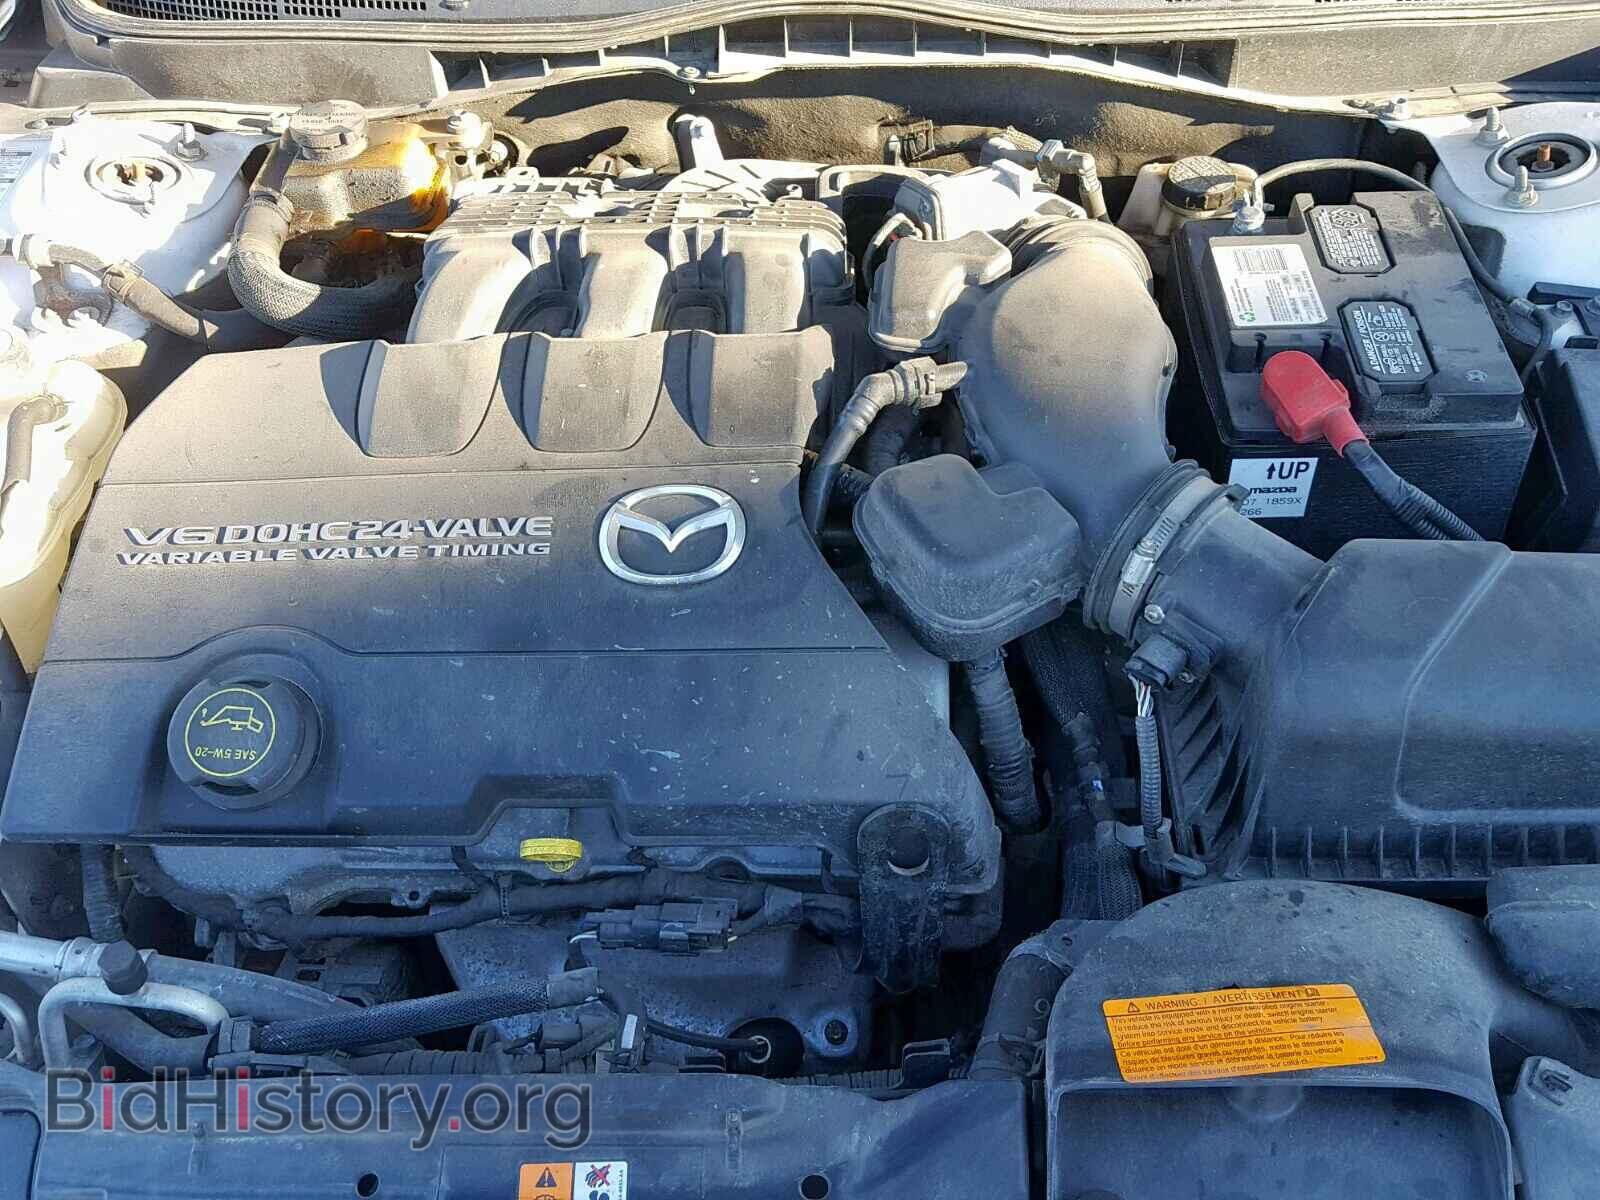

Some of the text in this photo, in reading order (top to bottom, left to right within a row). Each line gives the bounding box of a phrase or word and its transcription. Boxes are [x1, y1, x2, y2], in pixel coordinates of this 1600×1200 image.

[1362, 339, 1379, 365] DANGER
[1278, 461, 1310, 480] UP
[1250, 486, 1297, 494] mazda
[123, 526, 214, 546] V6
[221, 521, 350, 546] DOHC
[118, 542, 551, 566] VARIABLE VALVE TIMING
[195, 746, 257, 761] SAE 5W-20
[1213, 988, 1303, 1003] AVERTISSEMENT
[1124, 1023, 1148, 1031] reduce
[1150, 1021, 1161, 1029] the
[1164, 1020, 1175, 1028] risk
[1186, 1017, 1213, 1025] serious
[1214, 1015, 1233, 1024] injury
[1267, 1009, 1289, 1018] switch
[1129, 1015, 1153, 1023] vehicle
[1162, 1012, 1194, 1022] equipped
[1142, 1030, 1155, 1038] into
[1157, 1028, 1182, 1036] service
[1206, 1023, 1219, 1031] and
[1221, 1019, 1259, 1030] disconnect
[1260, 1018, 1272, 1026] the
[1273, 1017, 1298, 1025] vehicle
[1289, 1032, 1306, 1040] Pour
[1118, 1039, 1140, 1048] before
[1143, 1036, 1180, 1047] performing
[1182, 1035, 1195, 1043] any
[1197, 1033, 1222, 1041] service
[1234, 1028, 1246, 1036] the
[1123, 1058, 1149, 1068] risques
